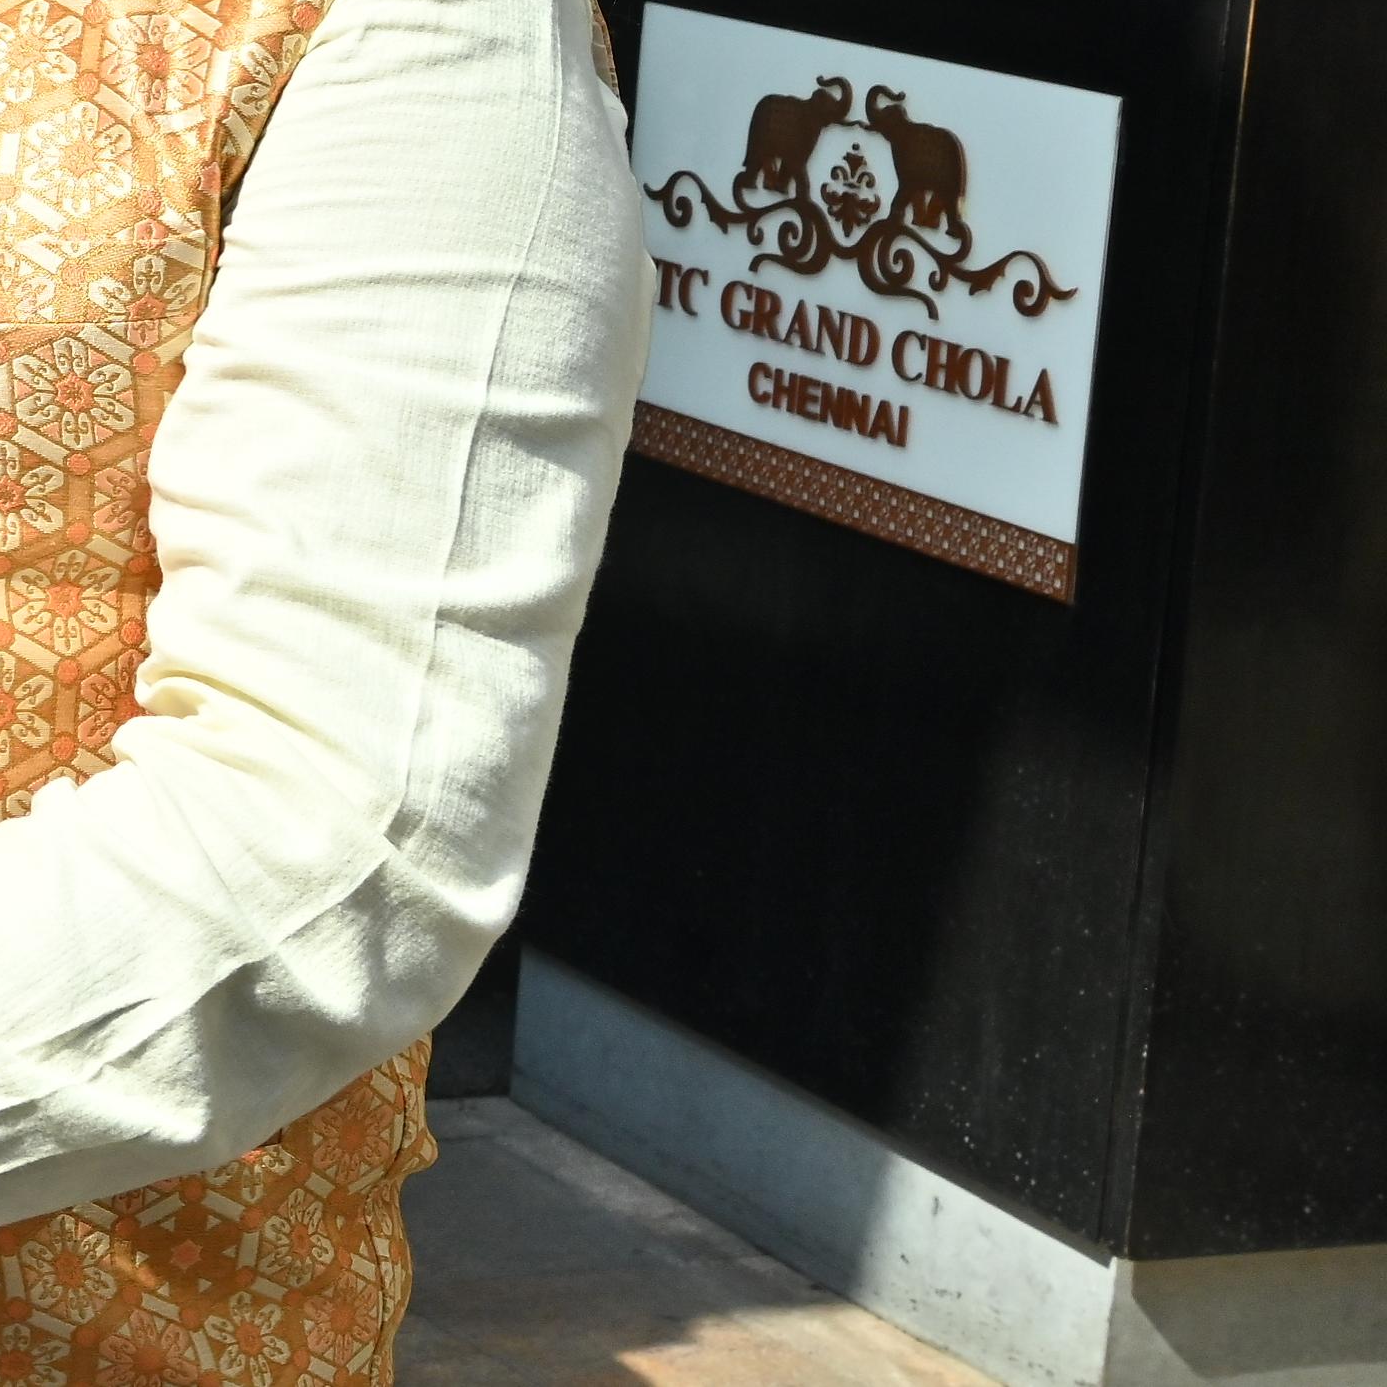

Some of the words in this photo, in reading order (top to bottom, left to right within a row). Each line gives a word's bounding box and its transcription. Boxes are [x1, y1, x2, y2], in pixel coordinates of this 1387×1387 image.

[651, 257, 709, 317] TC
[720, 280, 881, 367] GRAND
[891, 330, 1058, 425] CHOLA
[748, 361, 910, 448] CHENNAI
